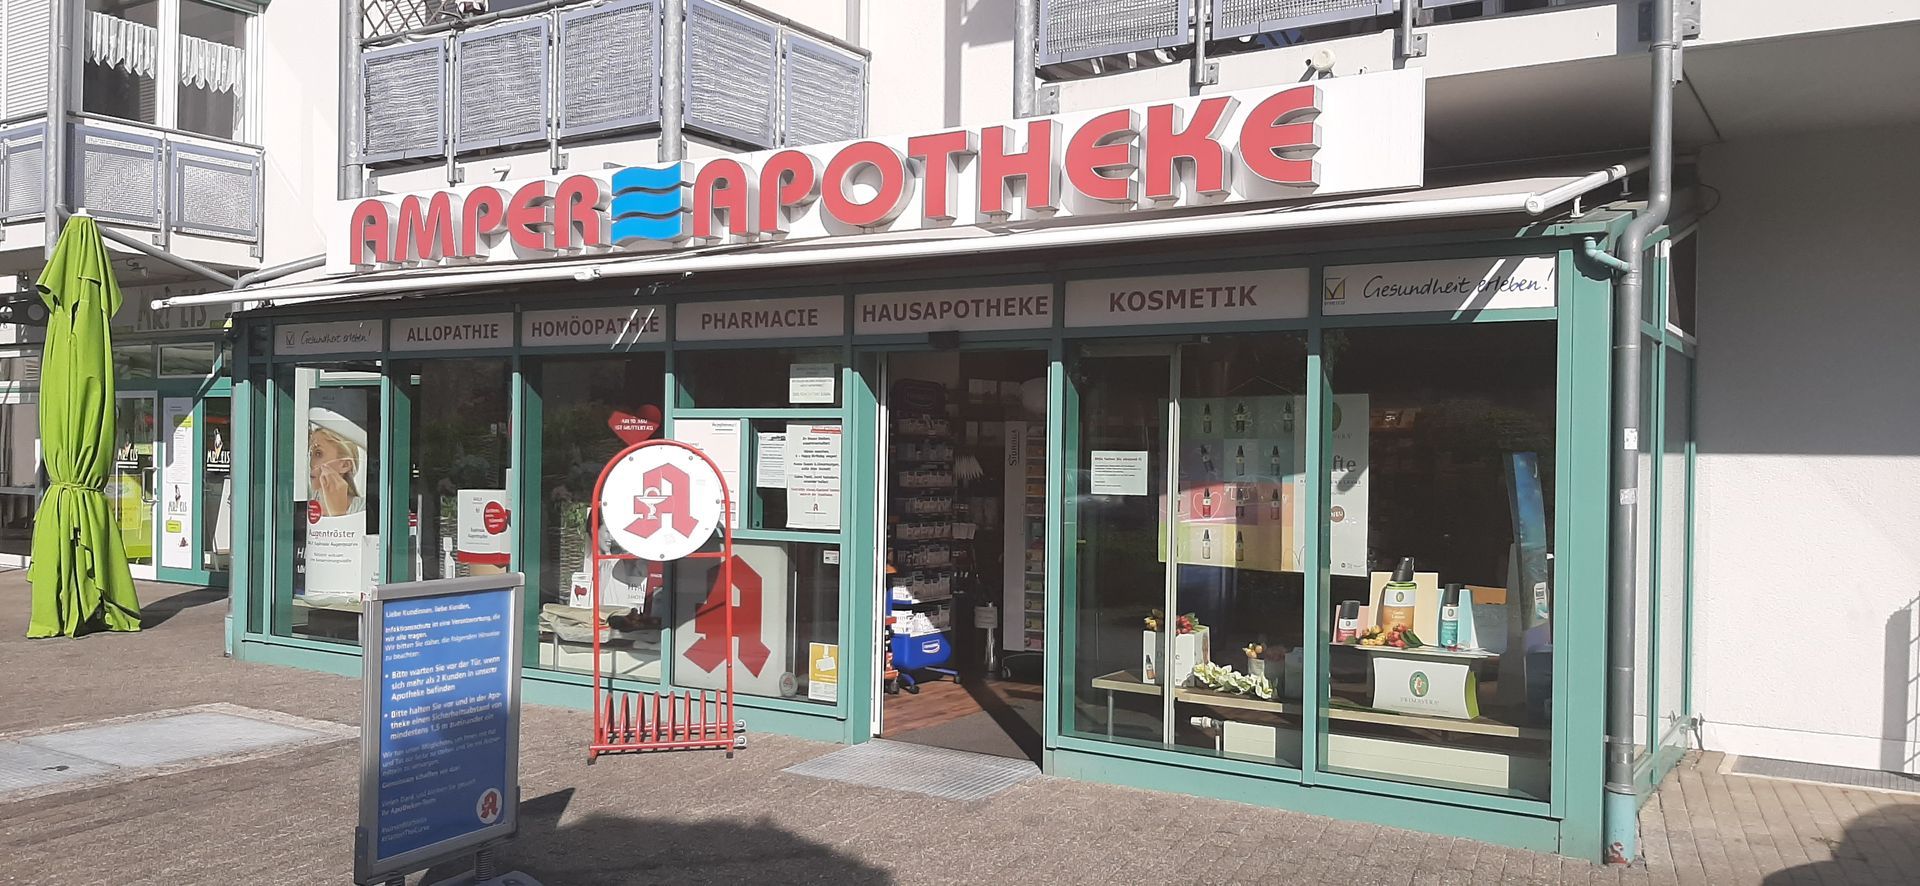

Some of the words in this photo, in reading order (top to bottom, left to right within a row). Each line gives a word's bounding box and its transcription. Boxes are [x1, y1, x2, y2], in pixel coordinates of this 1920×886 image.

[350, 175, 601, 266] AMPER
[694, 85, 1323, 239] APOTHEKE
[1363, 275, 1471, 299] Gesundheit
[1477, 266, 1555, 293] erleben!
[862, 295, 1049, 323] HAUSAPOTHEKE
[1109, 285, 1258, 313] KOSMETIK
[531, 315, 660, 338] HOMÖOPATHIE
[702, 308, 819, 331] PHARMACIE
[407, 323, 499, 342] ALLOPATHIE
[396, 642, 414, 650] bitten
[391, 682, 405, 690] sich
[406, 679, 424, 688] mehr
[442, 671, 467, 681] Kunden
[475, 667, 498, 676] unserer
[392, 671, 408, 679] Bitte
[410, 667, 434, 676] warten
[483, 656, 501, 664] wenn
[391, 689, 425, 702] Apotheke
[426, 684, 456, 695] befinden
[391, 709, 408, 718] Bitte
[409, 705, 431, 715] halten
[432, 703, 442, 711] Sie
[455, 698, 468, 706] und
[469, 696, 475, 704] in
[391, 720, 410, 729] theke
[412, 716, 431, 725] einen
[432, 703, 490, 721] Sicherheitsabstand
[390, 727, 429, 740] mindestens
